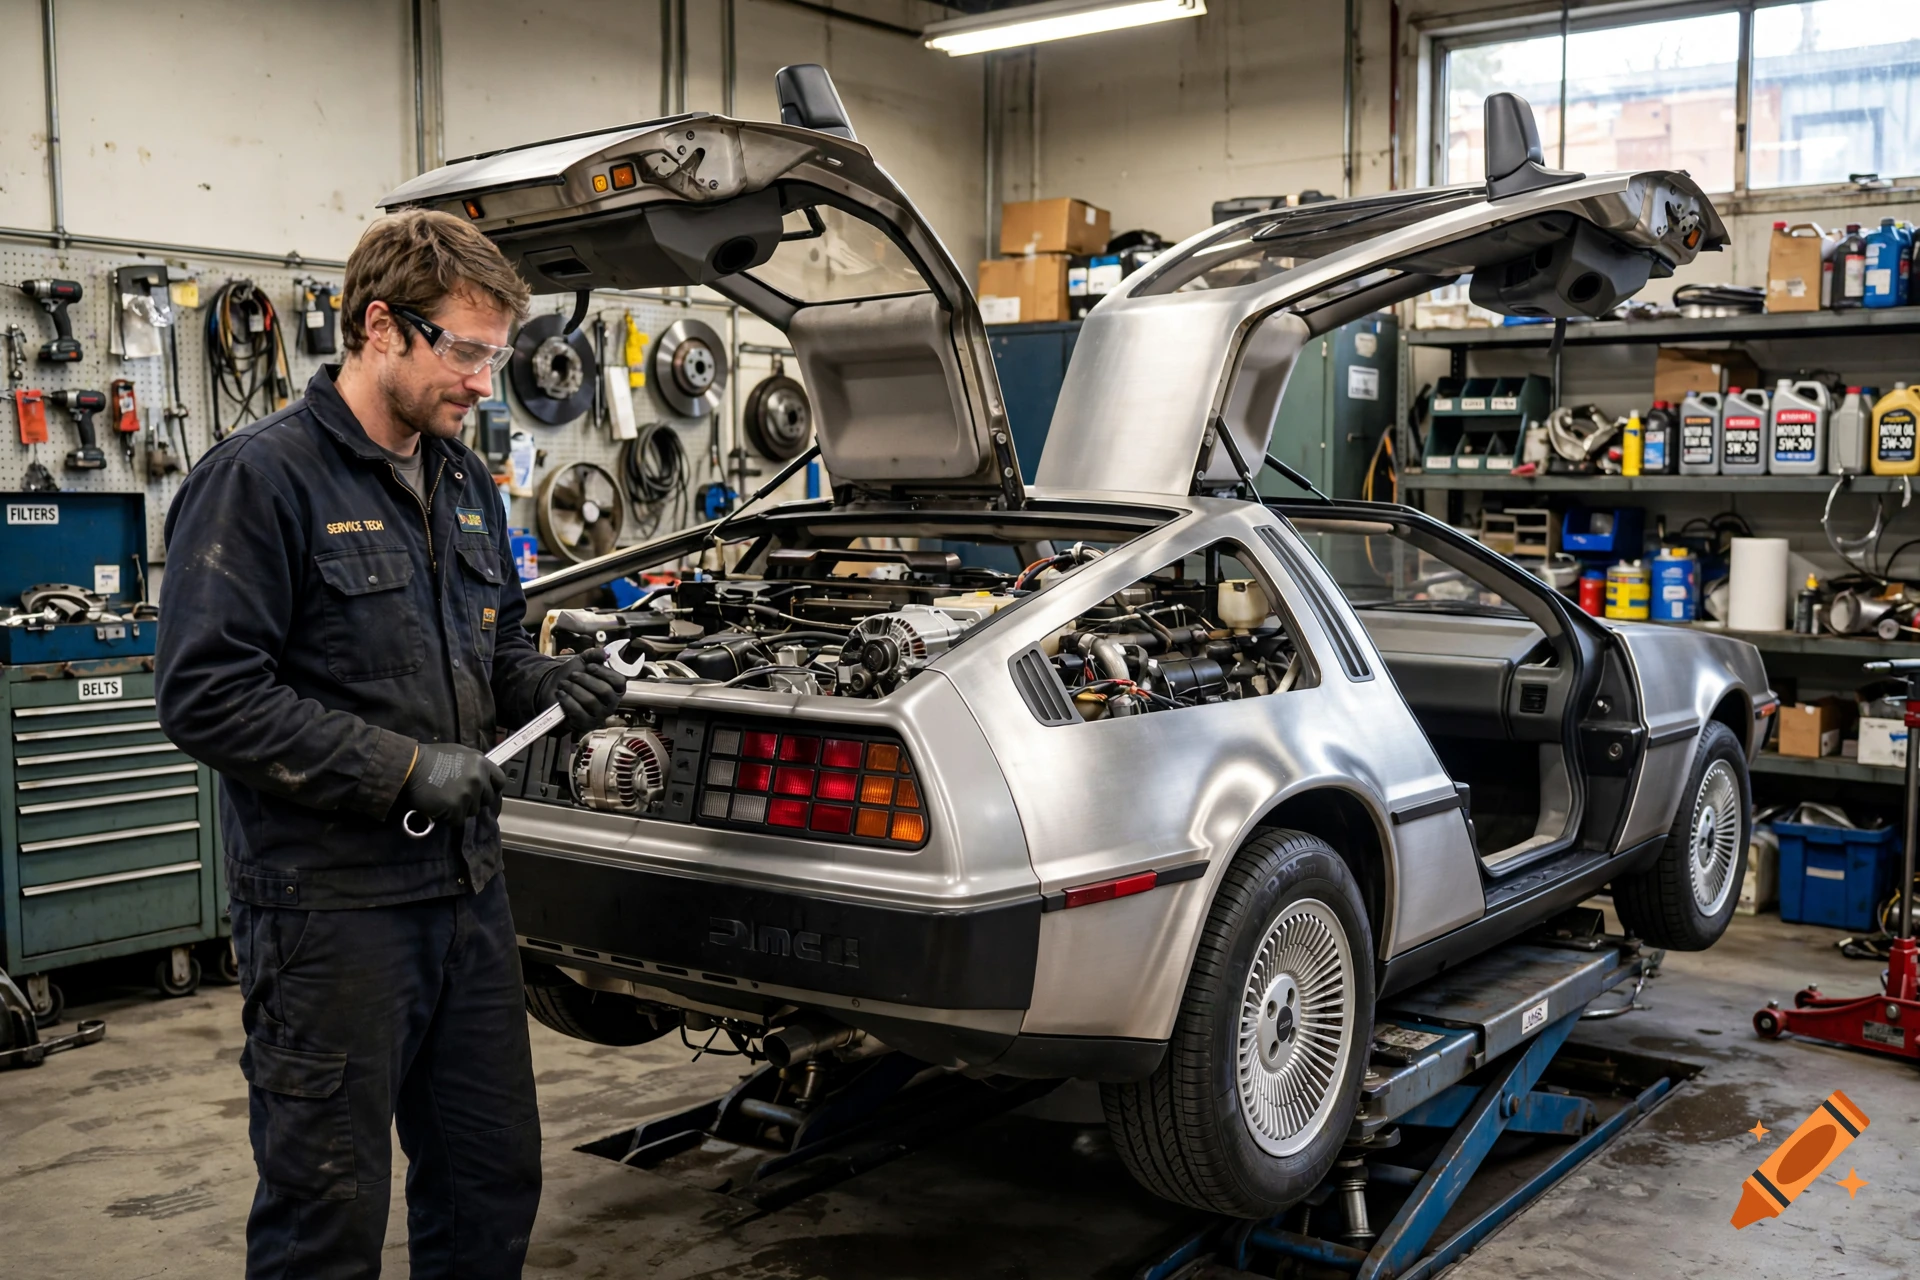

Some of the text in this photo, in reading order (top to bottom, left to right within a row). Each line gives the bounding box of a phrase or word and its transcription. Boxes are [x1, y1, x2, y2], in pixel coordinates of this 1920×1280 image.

[1802, 424, 1815, 437] OIL
[1903, 424, 1915, 436] OIL
[1726, 442, 1757, 455] 5W-30
[1778, 437, 1812, 451] 5W-30
[1881, 436, 1912, 449] 5W-30
[10, 507, 56, 521] FILTERS
[326, 520, 384, 534] SERVICE TECH
[82, 681, 119, 696] BELTS
